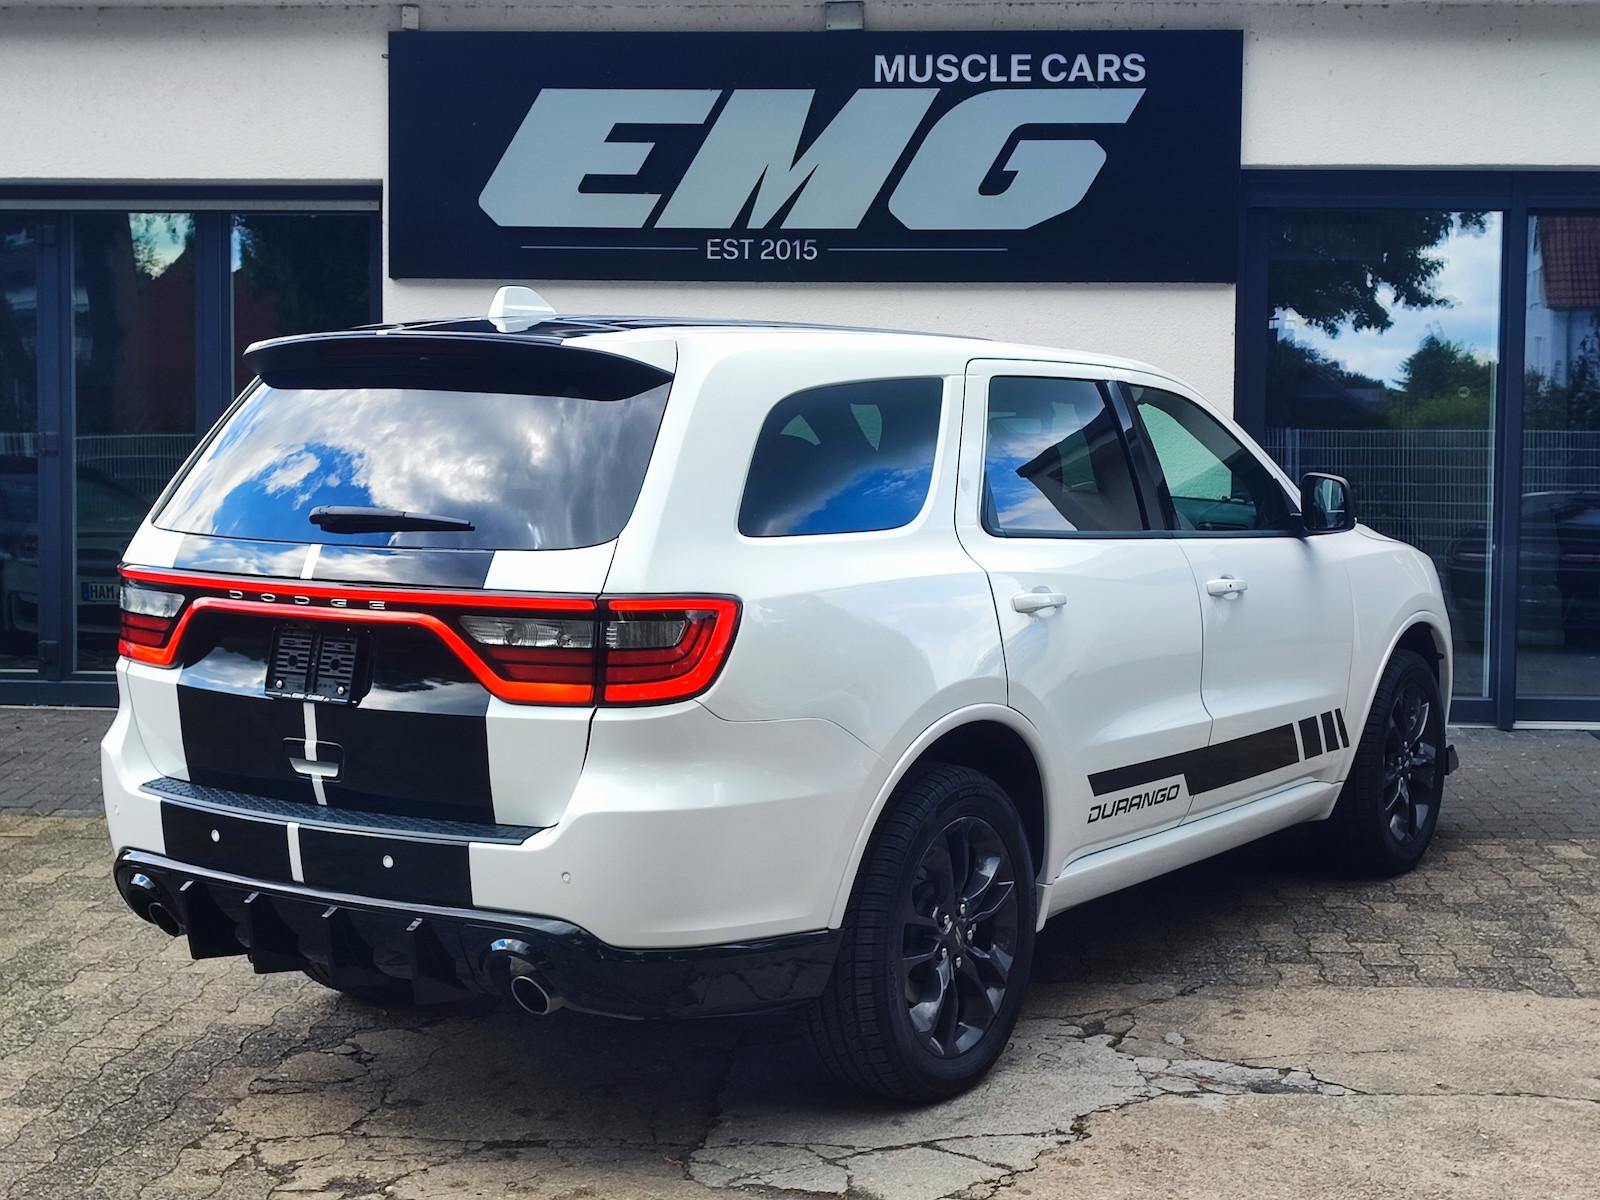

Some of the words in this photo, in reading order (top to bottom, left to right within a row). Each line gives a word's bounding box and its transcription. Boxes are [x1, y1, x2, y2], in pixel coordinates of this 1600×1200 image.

[874, 54, 1032, 83] MUSCLE
[1041, 53, 1146, 82] CARS
[479, 88, 1146, 230] EMG
[706, 238, 754, 260] EST
[760, 239, 818, 261] 2015
[90, 584, 115, 599] HAM
[229, 589, 386, 610] DODGE
[1087, 783, 1181, 824] DURANGO
